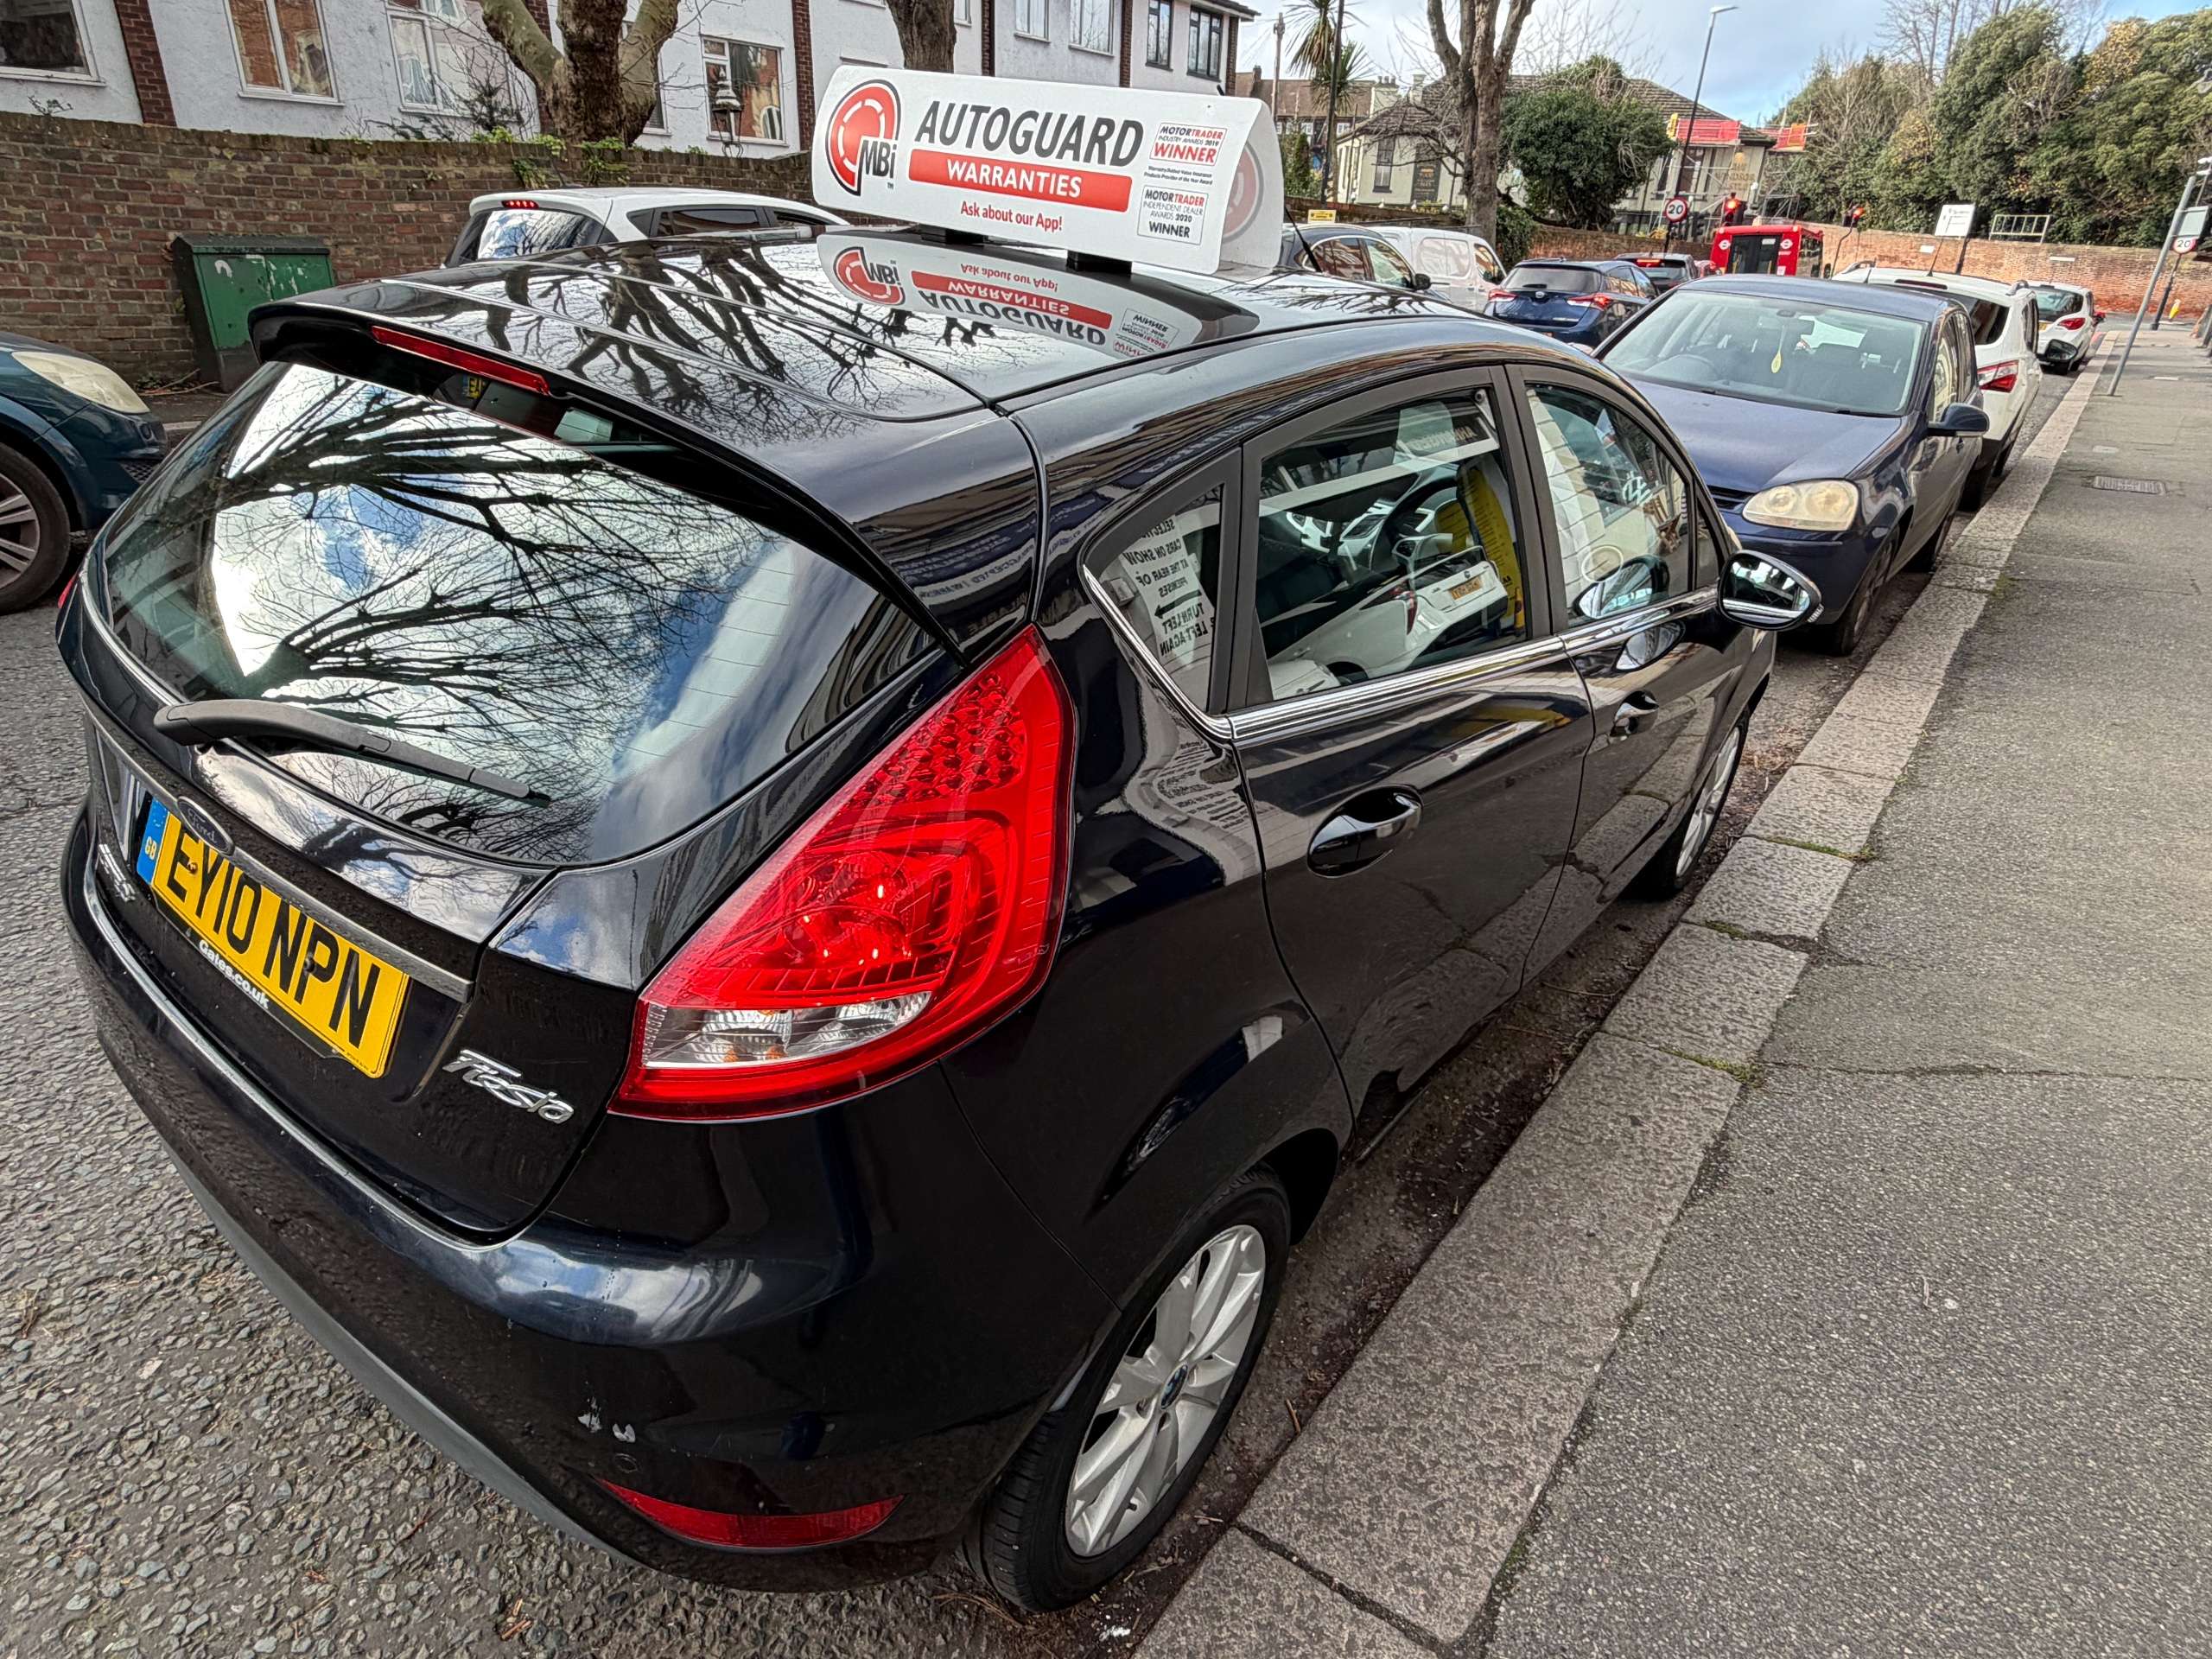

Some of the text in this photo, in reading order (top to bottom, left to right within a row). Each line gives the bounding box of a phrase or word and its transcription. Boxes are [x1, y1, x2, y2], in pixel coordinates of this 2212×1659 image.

[914, 100, 1144, 167] AUTOGUARD
[862, 139, 898, 179] MBi
[1154, 142, 1217, 163] WINNER
[947, 159, 1083, 198] WARRANTIES
[960, 200, 1063, 232] Ask about our App!
[1143, 200, 1204, 215] INDEPENDENT DEALER
[1150, 210, 1193, 223] AWARDS 2020
[1668, 204, 1684, 215] 20
[1148, 220, 1191, 238] WINNER
[2177, 239, 2191, 248] 20
[187, 807, 219, 844] Ford
[144, 836, 158, 861] GB
[166, 822, 263, 955] EY10
[262, 896, 382, 1048] NPN
[199, 939, 270, 1009] Gates.co.uk
